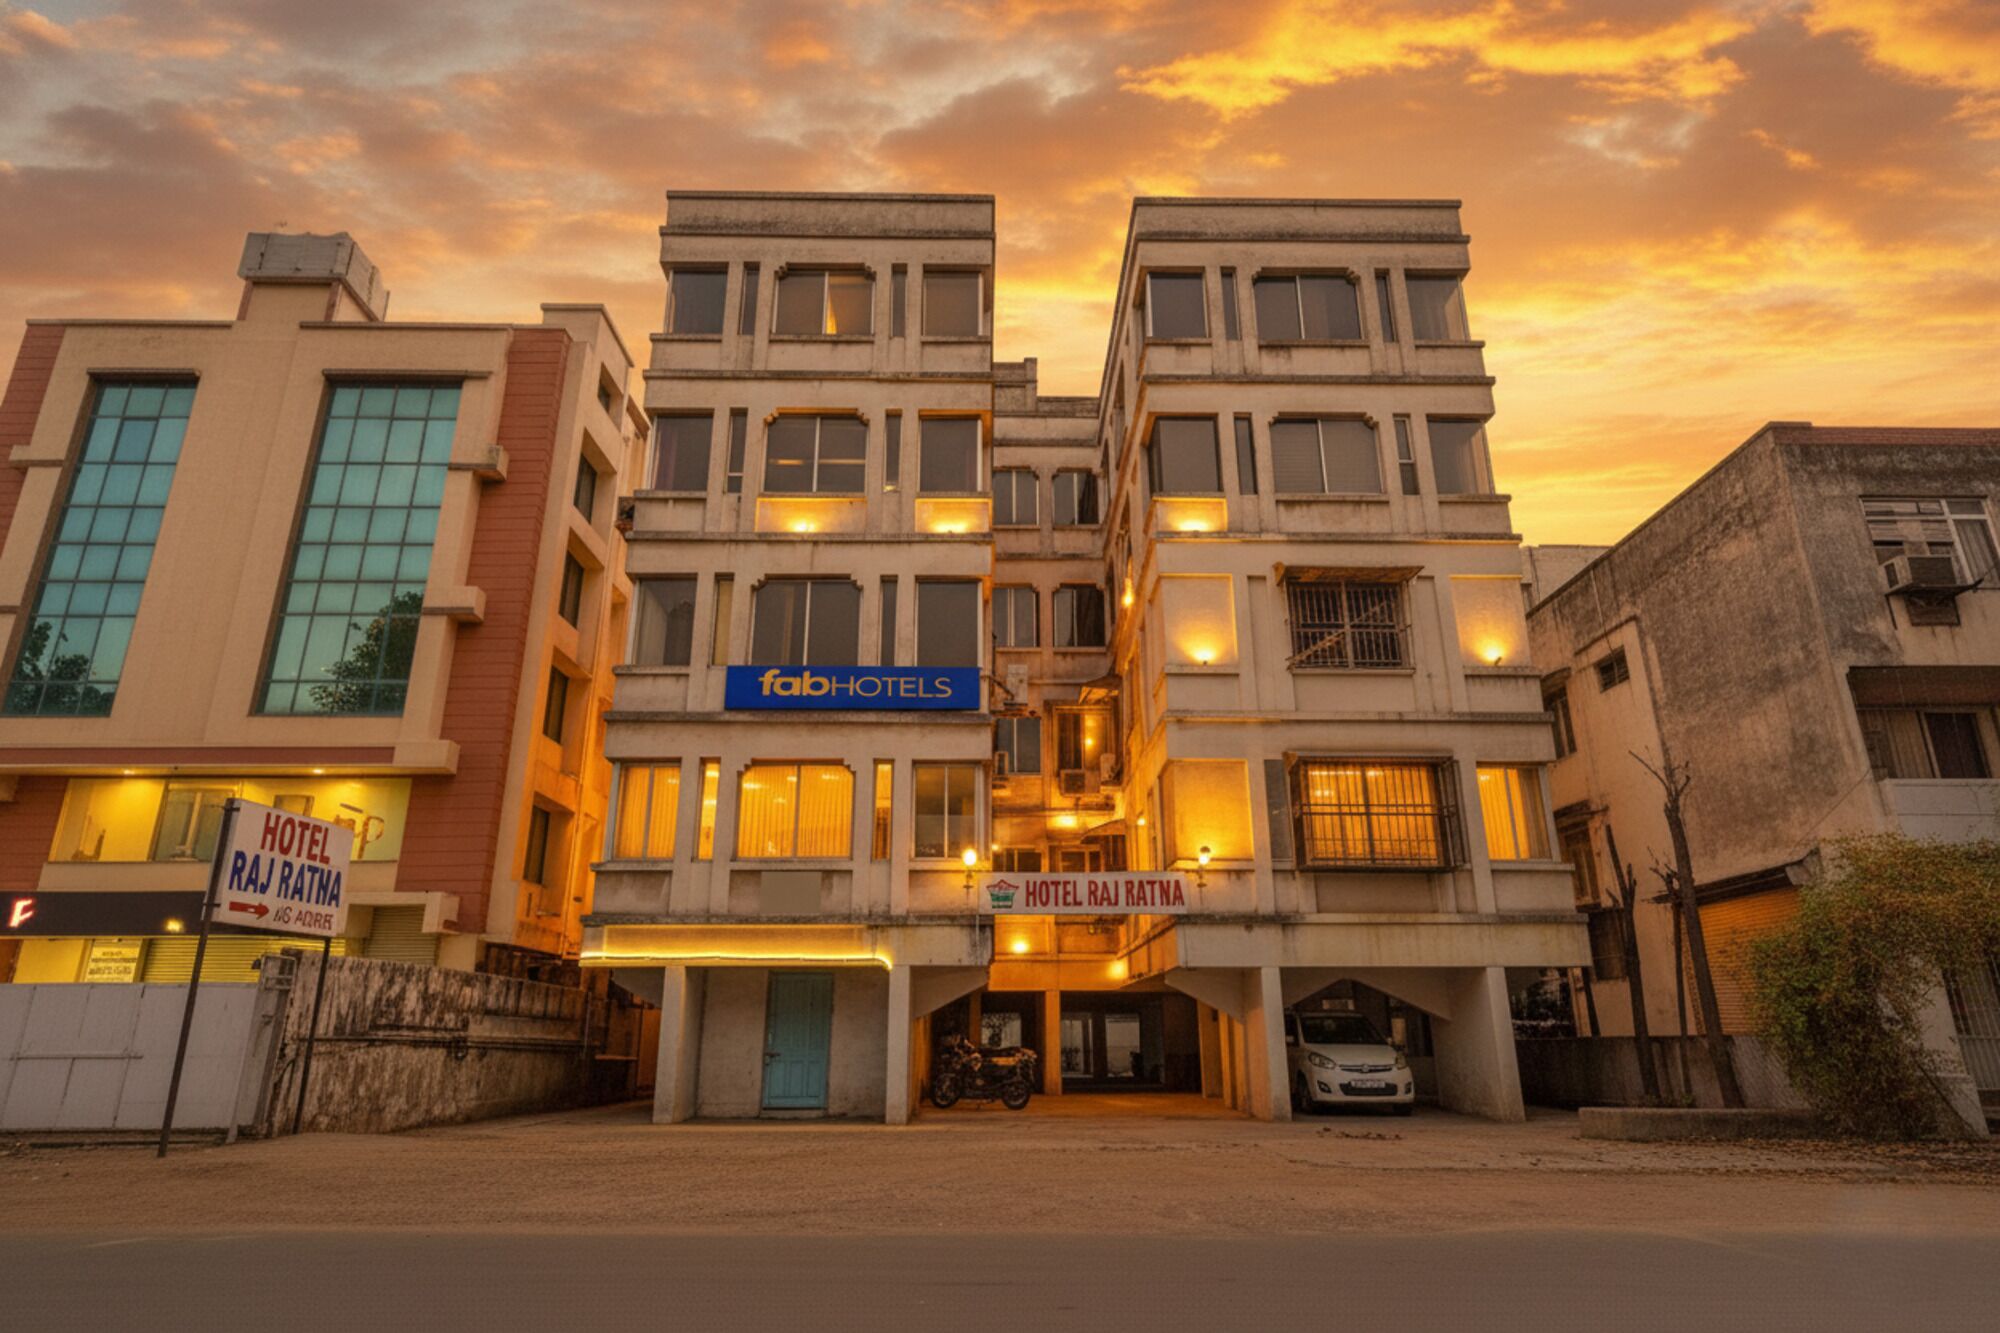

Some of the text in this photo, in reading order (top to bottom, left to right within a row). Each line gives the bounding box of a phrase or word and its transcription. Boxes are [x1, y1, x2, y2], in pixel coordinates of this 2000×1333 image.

[758, 668, 953, 698] fabHOTELS
[260, 812, 330, 864] HOTEL
[228, 850, 342, 908] RAJ RATNA
[1025, 880, 1185, 907] HOTEL RAJ RATNA
